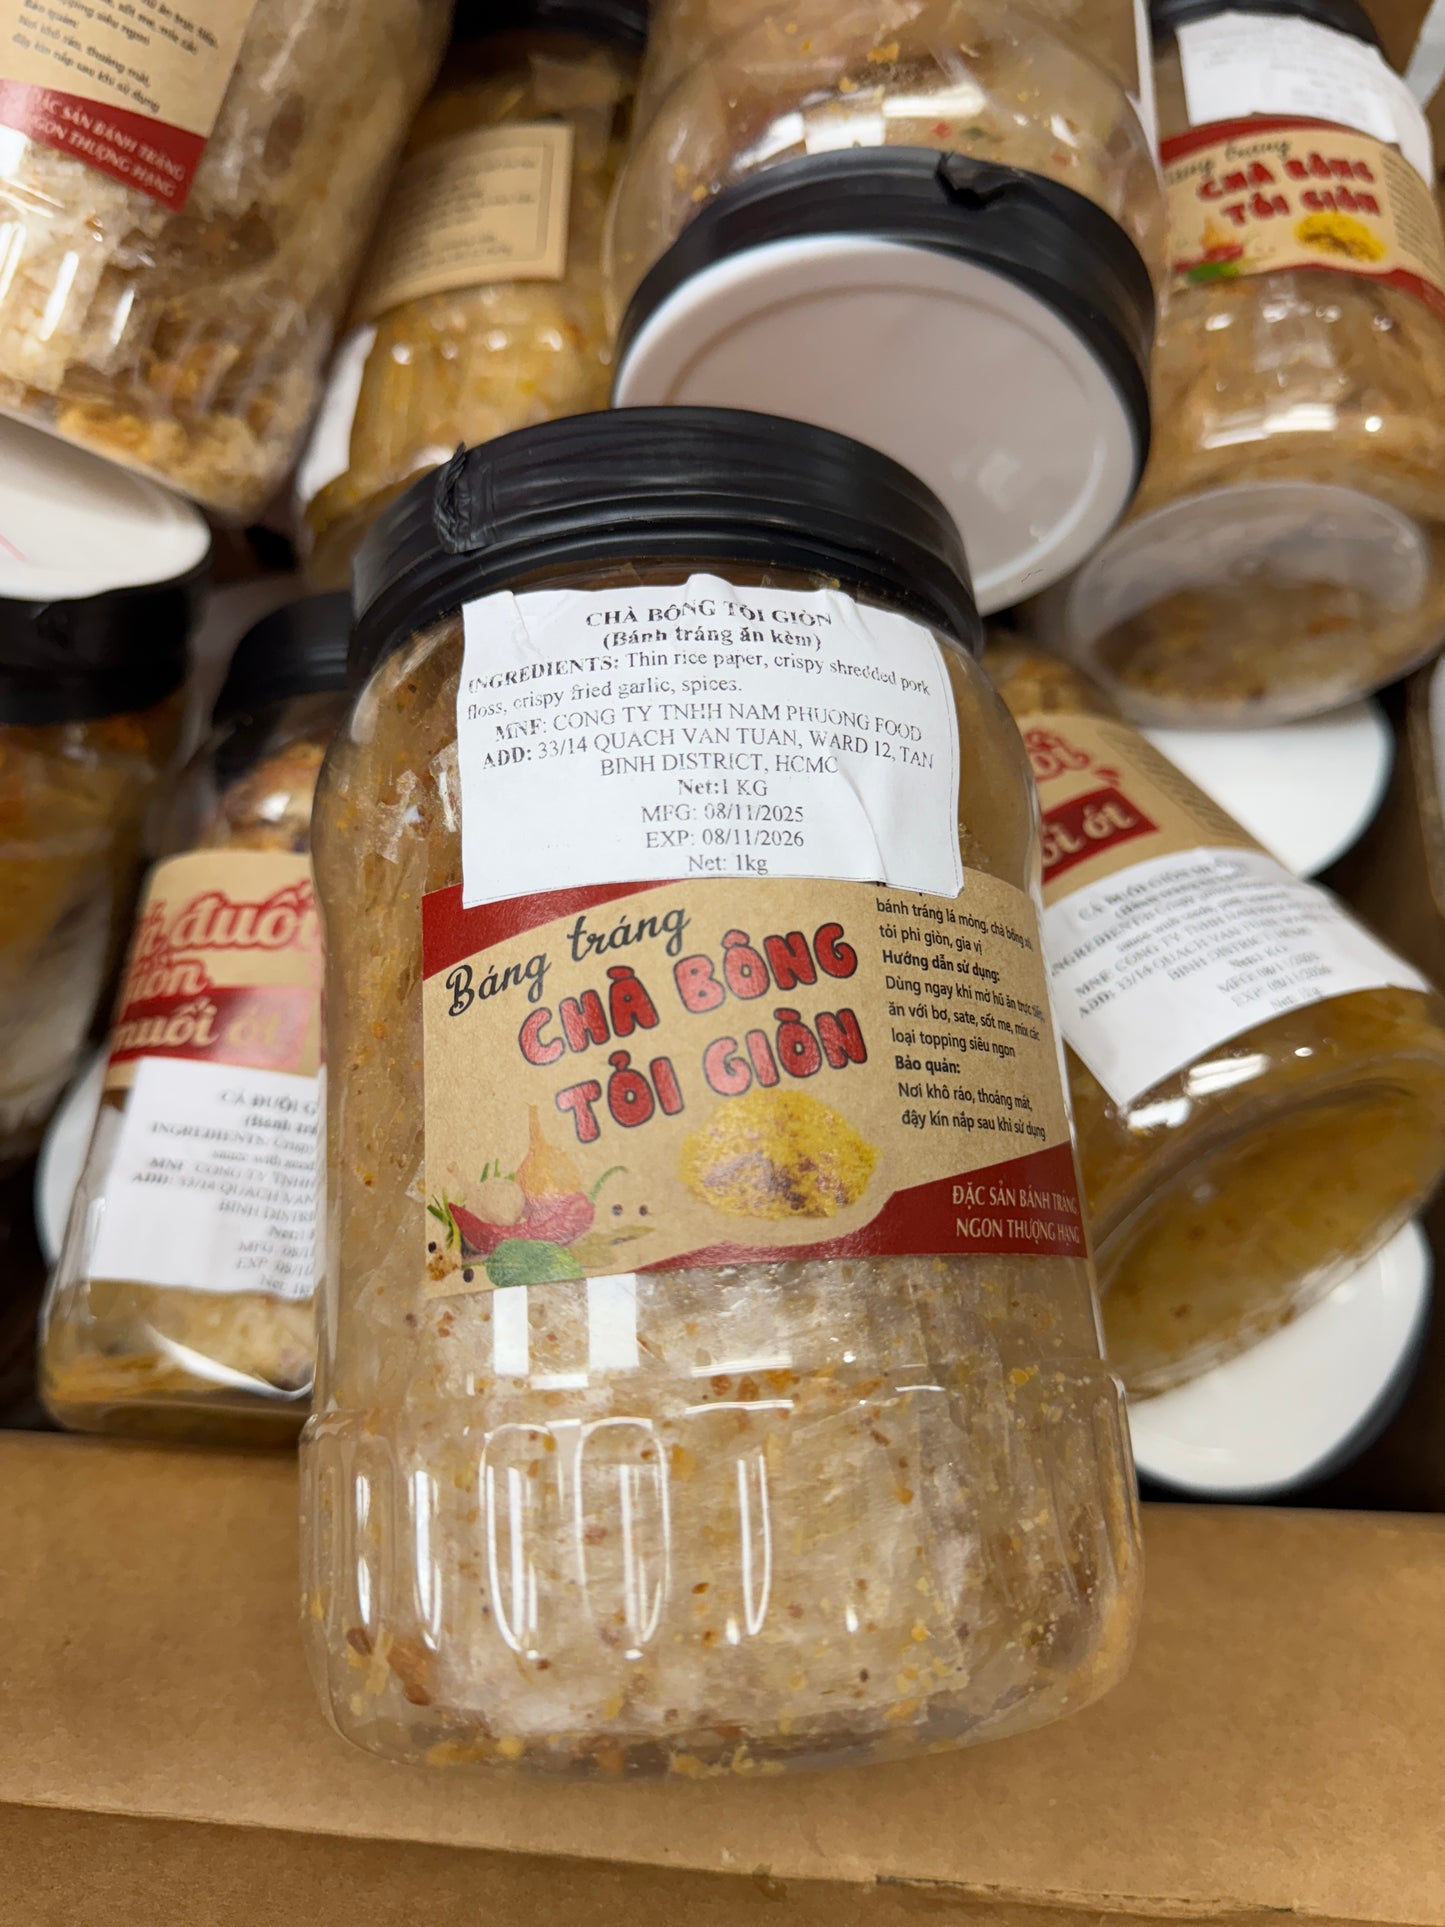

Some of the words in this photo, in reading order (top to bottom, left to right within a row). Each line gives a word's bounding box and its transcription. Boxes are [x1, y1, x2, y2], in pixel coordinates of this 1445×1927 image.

[586, 606, 638, 627] CHÀ
[648, 599, 716, 622] BÔNG
[772, 608, 832, 627] GIÒN
[603, 628, 667, 650] (Bánh
[675, 626, 734, 646] tráng
[770, 629, 822, 652] kèm)
[468, 656, 619, 693] INGREDIENTS:
[627, 652, 668, 668] Thin
[674, 651, 708, 665] rice
[713, 653, 769, 669] paper,
[774, 653, 824, 674] crispy
[830, 659, 897, 686] shredded
[900, 676, 931, 696] pork
[467, 703, 507, 721] floss,
[513, 690, 565, 709] crispy
[571, 681, 612, 701] fried
[618, 677, 675, 699] garlic,
[682, 674, 742, 698] spices.
[495, 718, 547, 742] MNF:
[553, 708, 616, 731] CONG
[622, 705, 652, 723] TY
[659, 703, 723, 721] TNHH
[728, 703, 780, 721] NAM
[786, 705, 870, 731] PHUONG
[875, 717, 922, 742] FOOD
[483, 746, 532, 770] ADD:
[538, 736, 588, 760] 33/14
[593, 729, 674, 753] QUACH
[682, 727, 730, 744] VAN
[735, 727, 803, 748] TUAN,
[809, 730, 868, 754] WARD
[874, 740, 896, 762] 12,
[900, 746, 934, 770] TAN
[600, 755, 655, 777] BINH
[662, 752, 769, 773] DISTRICT,
[775, 755, 839, 774] HCMC
[677, 779, 728, 795] Net:1
[737, 779, 768, 796] KG
[641, 803, 698, 823] MFG:
[704, 803, 804, 823] 08/11/2025
[646, 829, 695, 849] EXP:
[702, 828, 805, 847] 08/11/2026
[688, 854, 727, 872] Net:
[735, 854, 769, 875] 1kg
[876, 898, 909, 916] bánh
[911, 902, 943, 924] tráng
[945, 908, 956, 923] lá
[958, 914, 989, 935] mỏng,
[990, 922, 1005, 937] chà
[1006, 927, 1024, 949] bông
[879, 924, 897, 939] tỏi
[901, 926, 920, 942] phi
[924, 930, 953, 948] giòn,
[955, 933, 971, 953] gia
[973, 940, 983, 956] vị
[445, 948, 552, 1017] Báng
[565, 906, 692, 963] tráng
[882, 949, 929, 971] Hướng
[932, 953, 954, 972] dẫn
[957, 960, 970, 974] sử
[972, 964, 1000, 984] dụng:
[518, 964, 660, 1067] CHÀ
[673, 921, 858, 1015] BÔNG
[885, 975, 921, 996] Dùng
[925, 982, 953, 999] ngay
[956, 983, 972, 999] khi
[974, 989, 991, 1003] mở
[1006, 995, 1016, 1010] ăn
[888, 1001, 905, 1016] ăn
[908, 1002, 928, 1018] với
[932, 1004, 951, 1022] bơ,
[953, 1010, 978, 1027] sate,
[980, 1013, 997, 1029] sốt
[997, 1020, 1014, 1034] me,
[892, 1028, 916, 1049] loại
[920, 1031, 967, 1052] topping
[969, 1036, 990, 1051] siêu
[992, 1043, 1016, 1058] ngon
[555, 1050, 685, 1144] TỎI
[702, 1007, 869, 1097] GIÒN
[895, 1055, 922, 1071] Bảo
[925, 1058, 961, 1076] quản:
[898, 1082, 923, 1097] Nơi
[926, 1083, 950, 1099] khô
[953, 1086, 975, 1104] ráo,
[978, 1088, 1013, 1110] thoáng
[1015, 1096, 1033, 1112] mát,
[901, 1109, 926, 1129] đậy
[930, 1110, 949, 1125] kín
[952, 1111, 975, 1132] nắp
[977, 1119, 995, 1130] sau
[997, 1116, 1013, 1132] khi
[1014, 1120, 1024, 1134] sử
[1026, 1121, 1046, 1141] dụng
[952, 1181, 985, 1209] ĐẶC
[989, 1179, 1017, 1206] SẢN
[1019, 1184, 1051, 1210] BÁNH
[956, 1216, 1003, 1238] NGON
[1007, 1216, 1056, 1246] THƯỢNG
[1057, 1223, 1081, 1247] HẠNG
